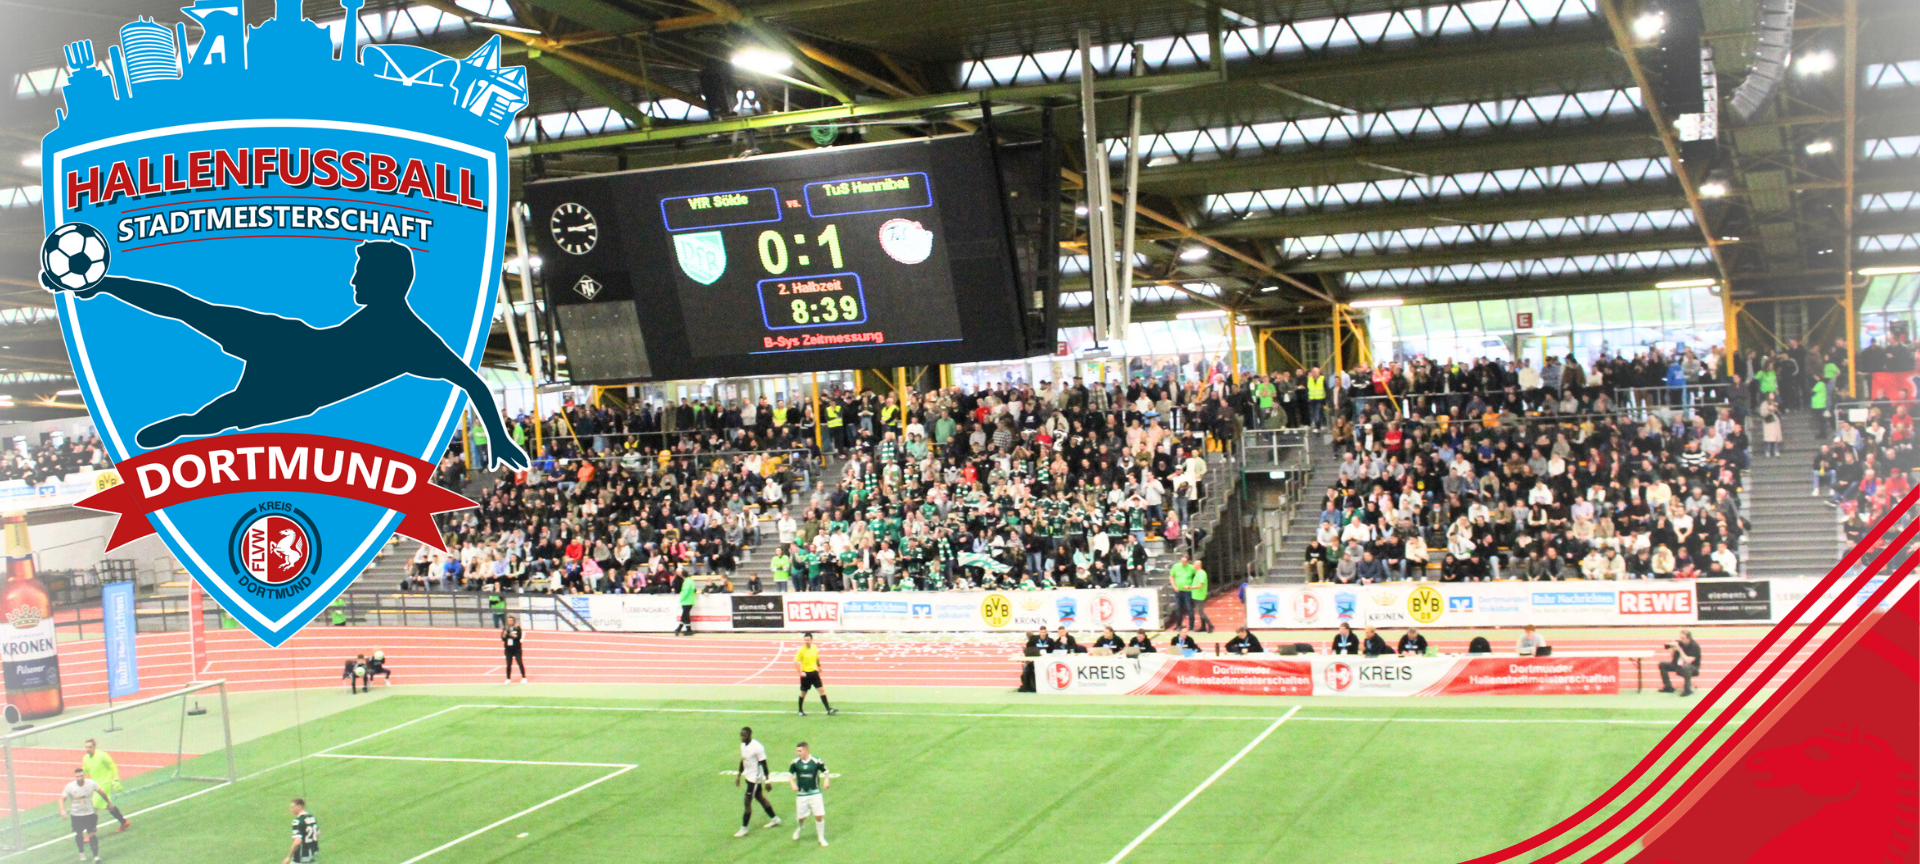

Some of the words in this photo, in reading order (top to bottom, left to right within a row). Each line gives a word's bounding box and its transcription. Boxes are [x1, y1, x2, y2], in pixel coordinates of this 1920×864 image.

[822, 181, 850, 197] TuS
[852, 177, 910, 195] Hannibal
[688, 196, 711, 210] VfR
[713, 193, 748, 208] Sölde
[785, 199, 802, 209] vs.
[757, 223, 843, 275] 0:1
[777, 282, 790, 295] 2.
[792, 279, 842, 294] Halbzeit
[790, 295, 858, 324] 8:39
[1519, 314, 1529, 327] E
[763, 335, 800, 349] B-Sys
[801, 331, 884, 347] Zeitmessung
[1057, 343, 1065, 354] F
[985, 598, 1009, 618] BVB
[1413, 591, 1440, 612] BVB
[1622, 592, 1690, 613] REWE
[789, 603, 836, 620] REWE
[1369, 612, 1405, 621] KRONEN
[1014, 617, 1048, 625] KRONEN
[2, 637, 53, 656] KRONEN
[117, 661, 129, 685] Ruhr
[1077, 665, 1126, 680] KREIS
[1213, 665, 1271, 674] Dortmunder
[1359, 665, 1413, 681] KREIS
[1510, 664, 1573, 674] Dortmunder
[1177, 675, 1310, 685] Hallenstadtmeisterschaften
[1469, 675, 1616, 685] Hallenstadtmeisterschaften
